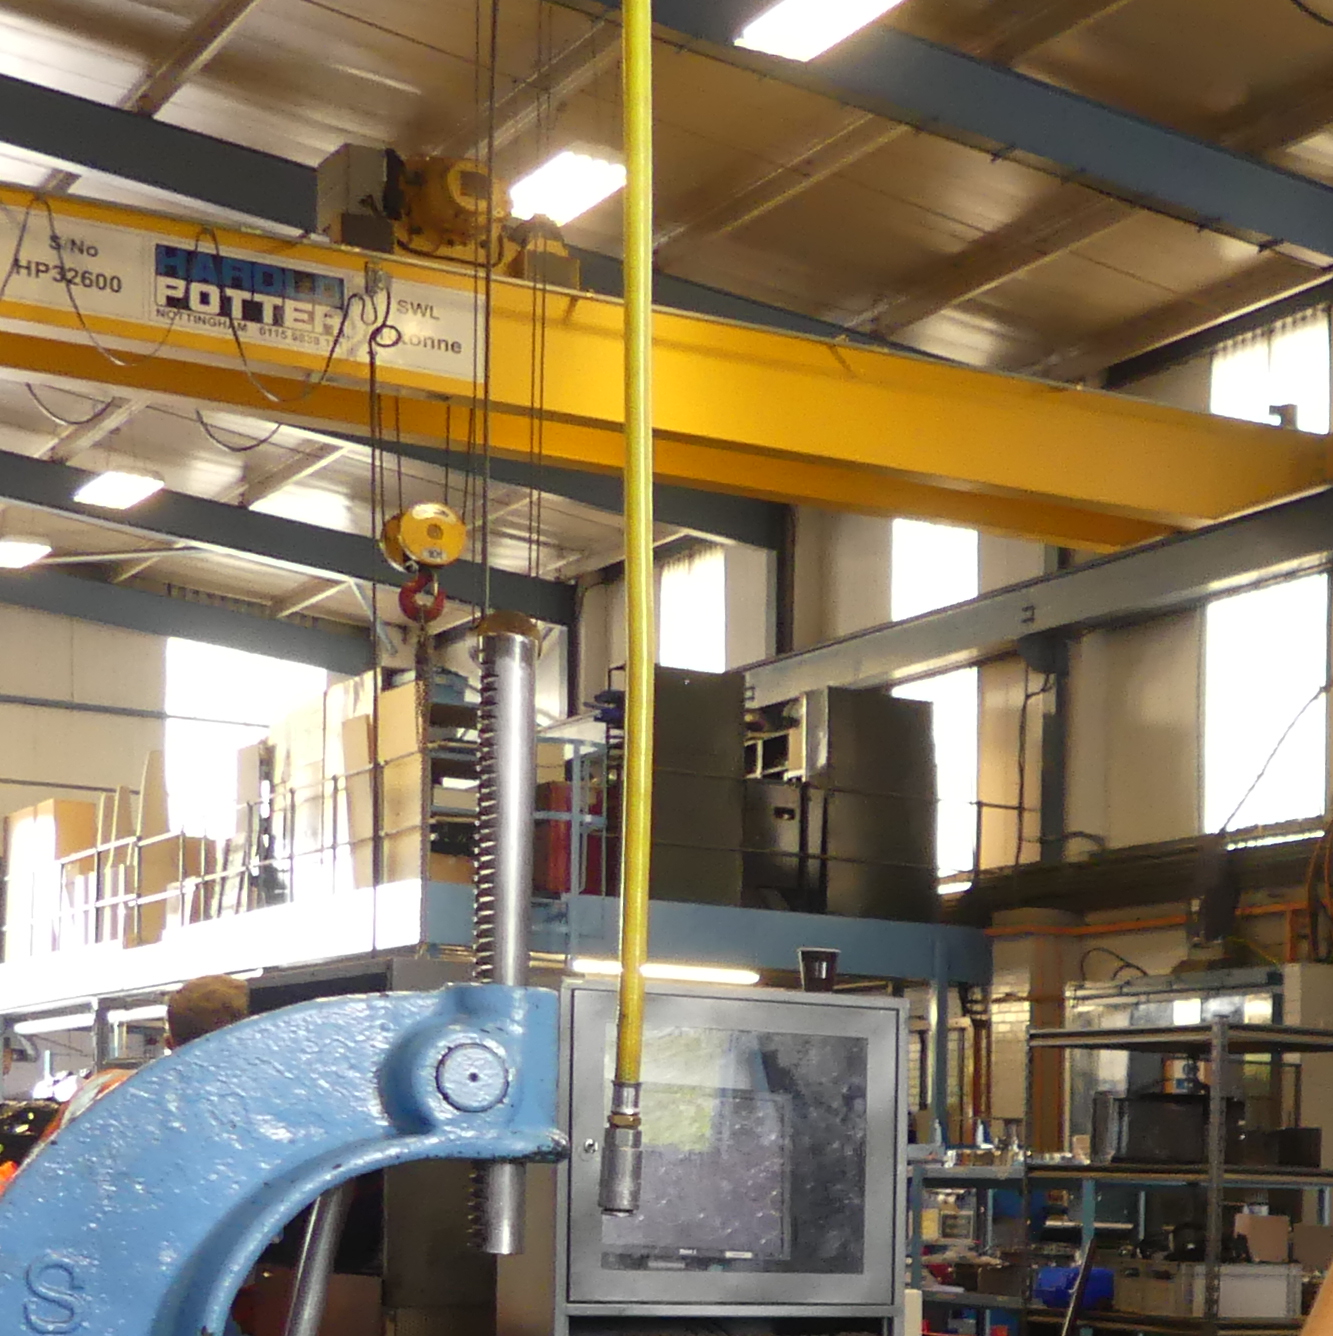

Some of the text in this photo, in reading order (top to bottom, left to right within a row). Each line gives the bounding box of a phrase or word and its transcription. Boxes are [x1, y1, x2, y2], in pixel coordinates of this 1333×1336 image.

[15, 258, 122, 293] HP32600
[156, 244, 344, 310] HAROLD
[156, 275, 343, 336] POTTER
[156, 308, 248, 332] NOTTINGHAM
[397, 299, 440, 321] SWL
